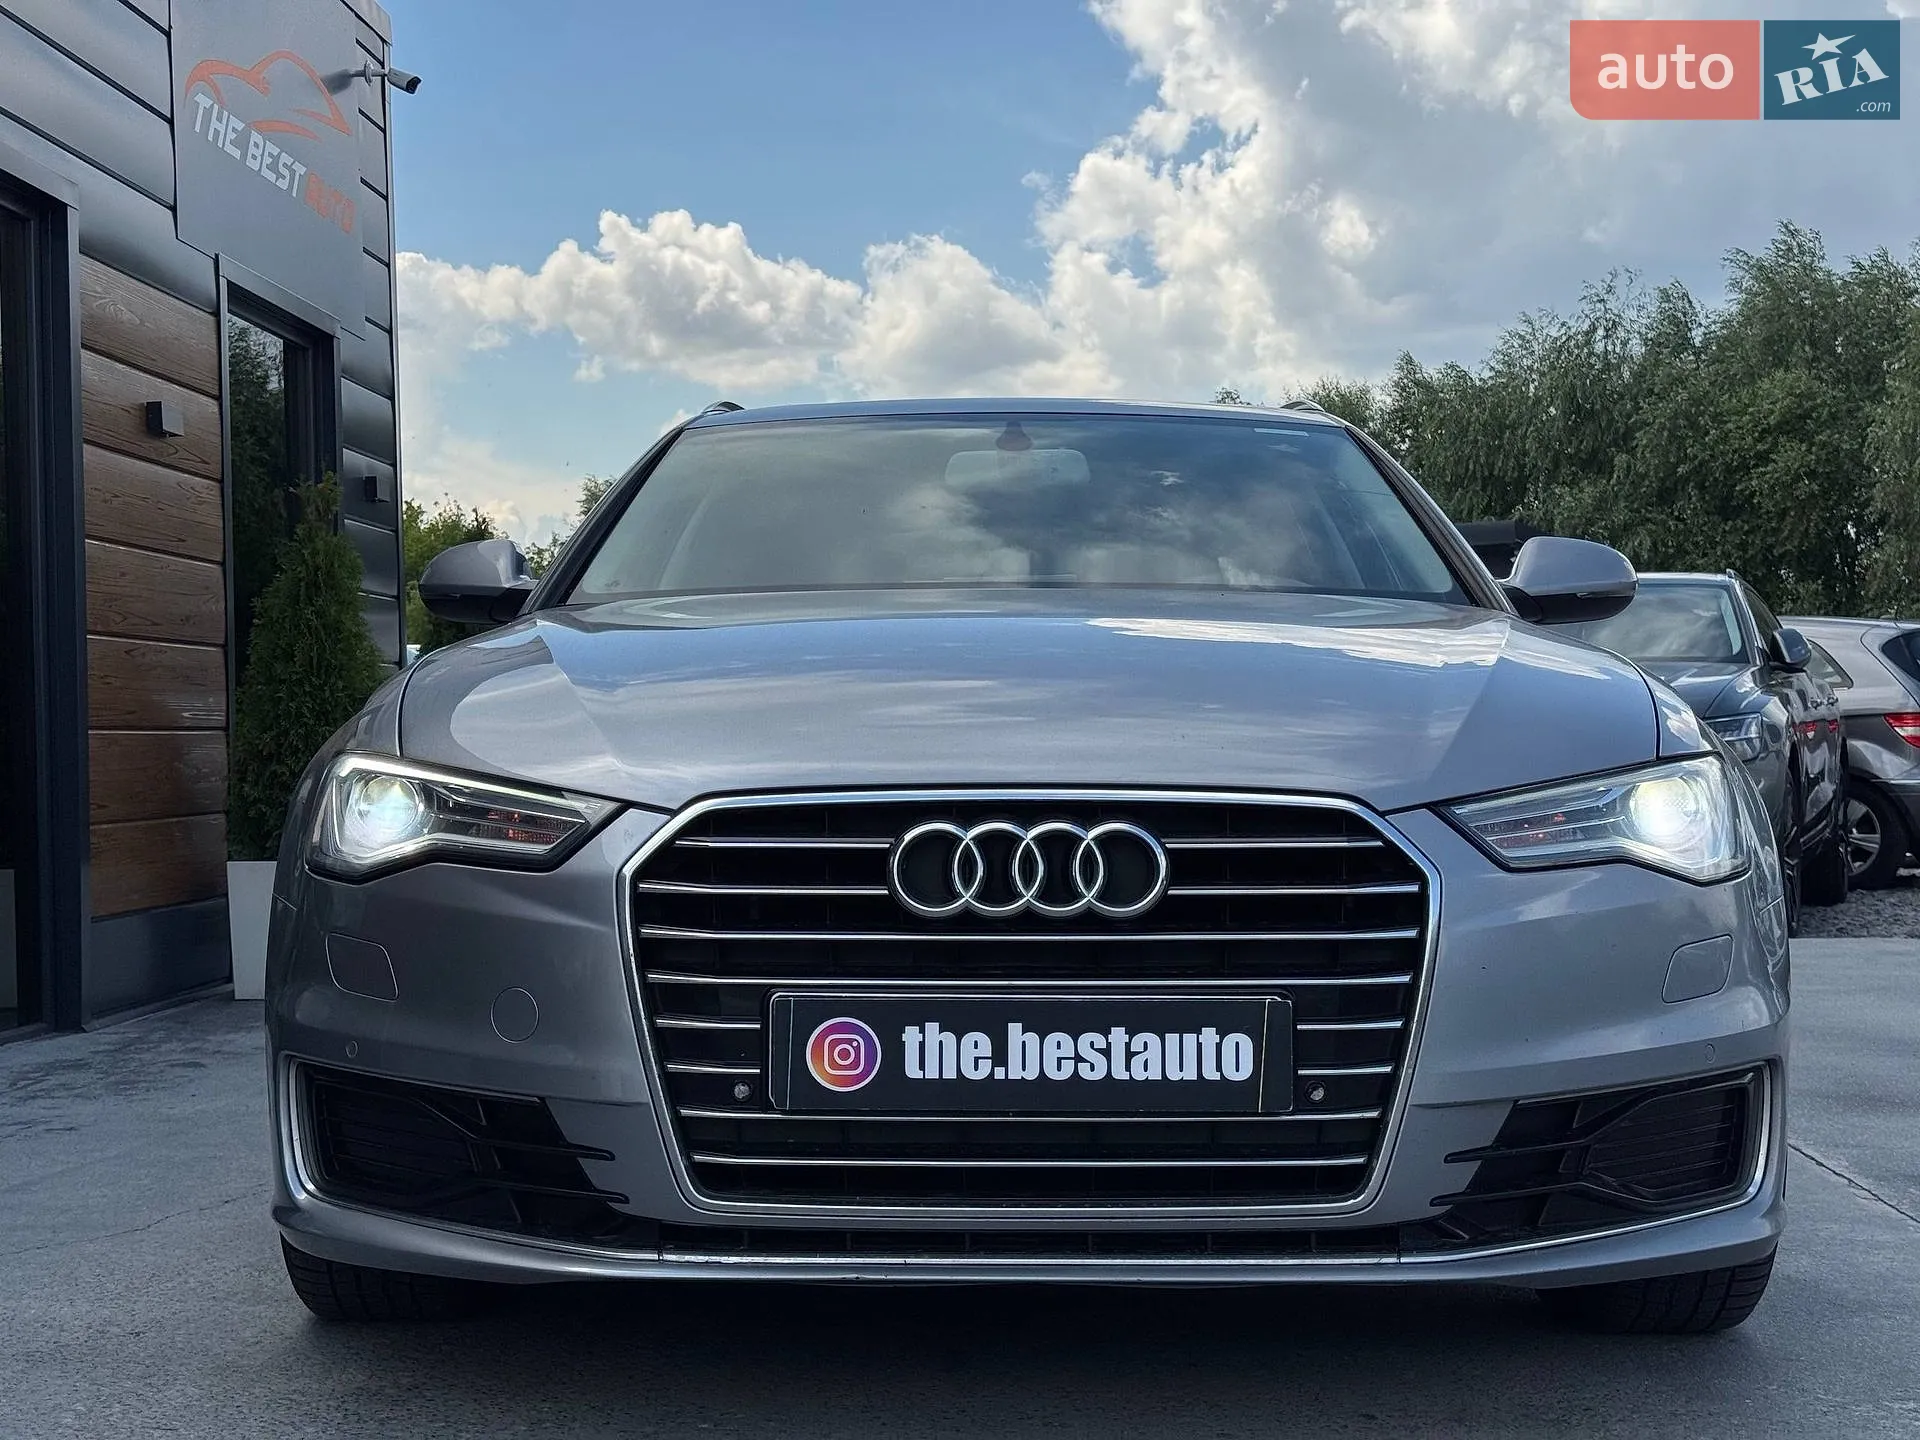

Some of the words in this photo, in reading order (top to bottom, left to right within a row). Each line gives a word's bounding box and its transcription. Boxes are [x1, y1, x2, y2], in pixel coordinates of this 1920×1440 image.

[193, 93, 246, 160] THE
[246, 130, 307, 197] BEST
[902, 1022, 1254, 1081] the.bestauto
